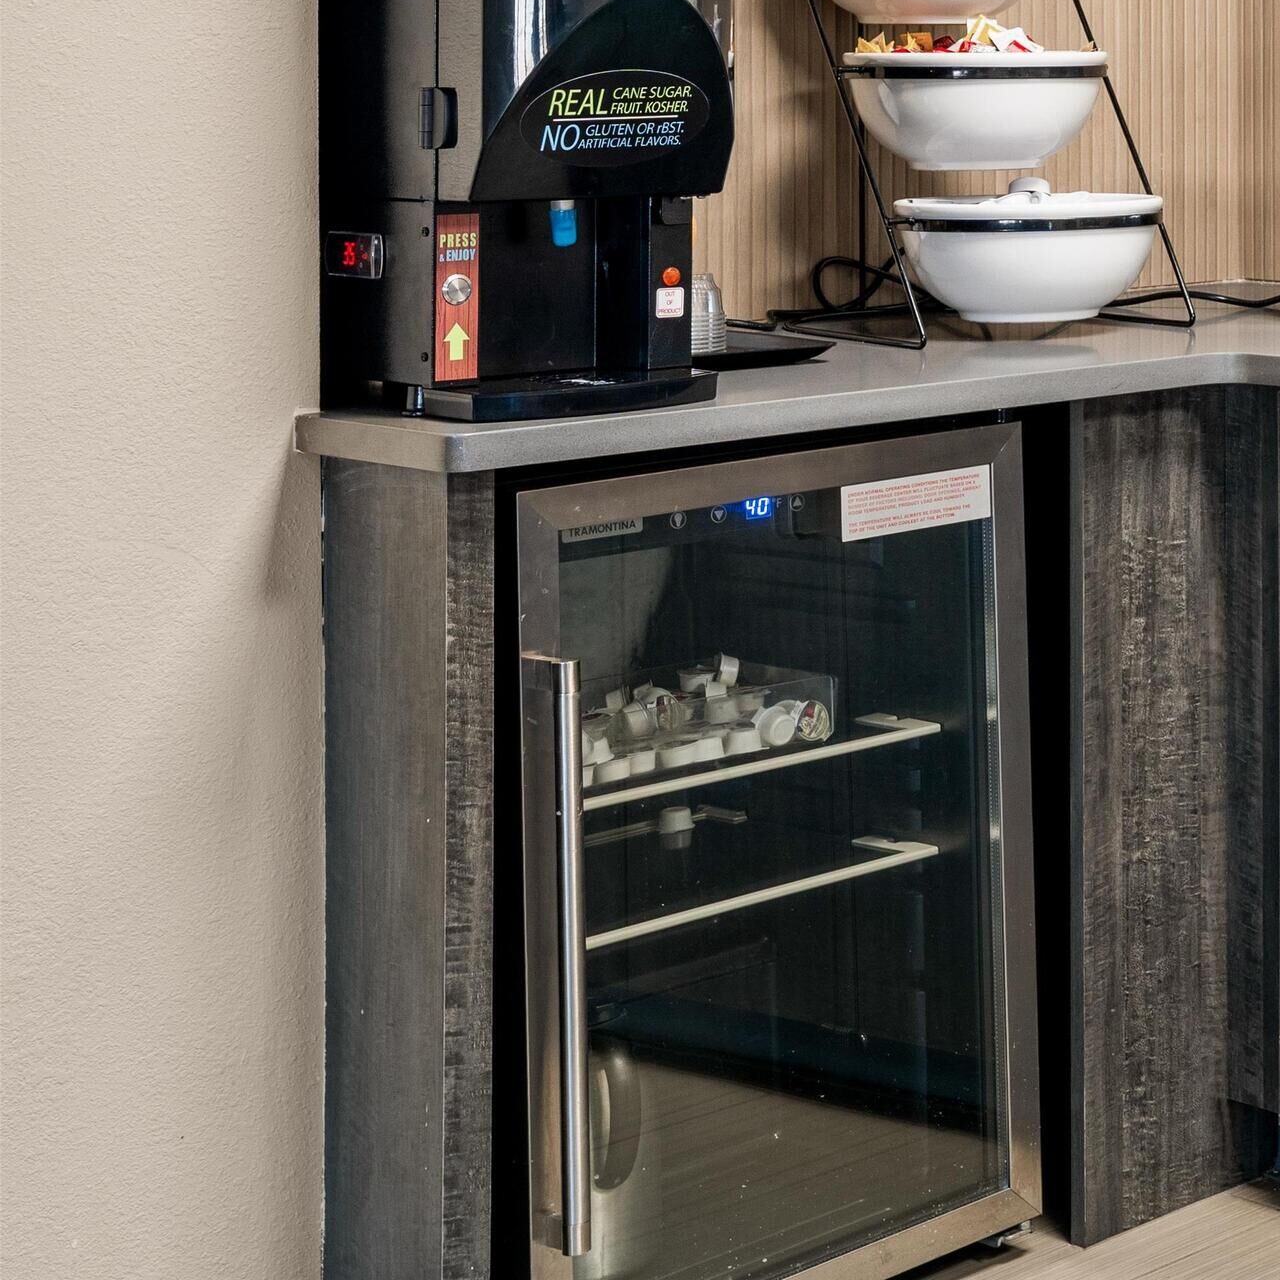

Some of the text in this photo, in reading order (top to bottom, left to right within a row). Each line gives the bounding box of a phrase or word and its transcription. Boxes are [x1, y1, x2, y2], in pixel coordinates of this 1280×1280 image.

[612, 85, 693, 100] CANE SUGAR.
[548, 88, 608, 117] REAL
[610, 100, 690, 115] FRUIT. KOSHER.
[585, 121, 686, 137] GLUTEN OR rBST.
[540, 124, 581, 152] NO
[577, 135, 682, 150] ARTIFICIAL FLAVORS.
[439, 232, 477, 248] PRESS
[439, 248, 476, 262] & ENJOY
[745, 497, 769, 516] 40
[568, 521, 637, 538] TRAMONTINA
